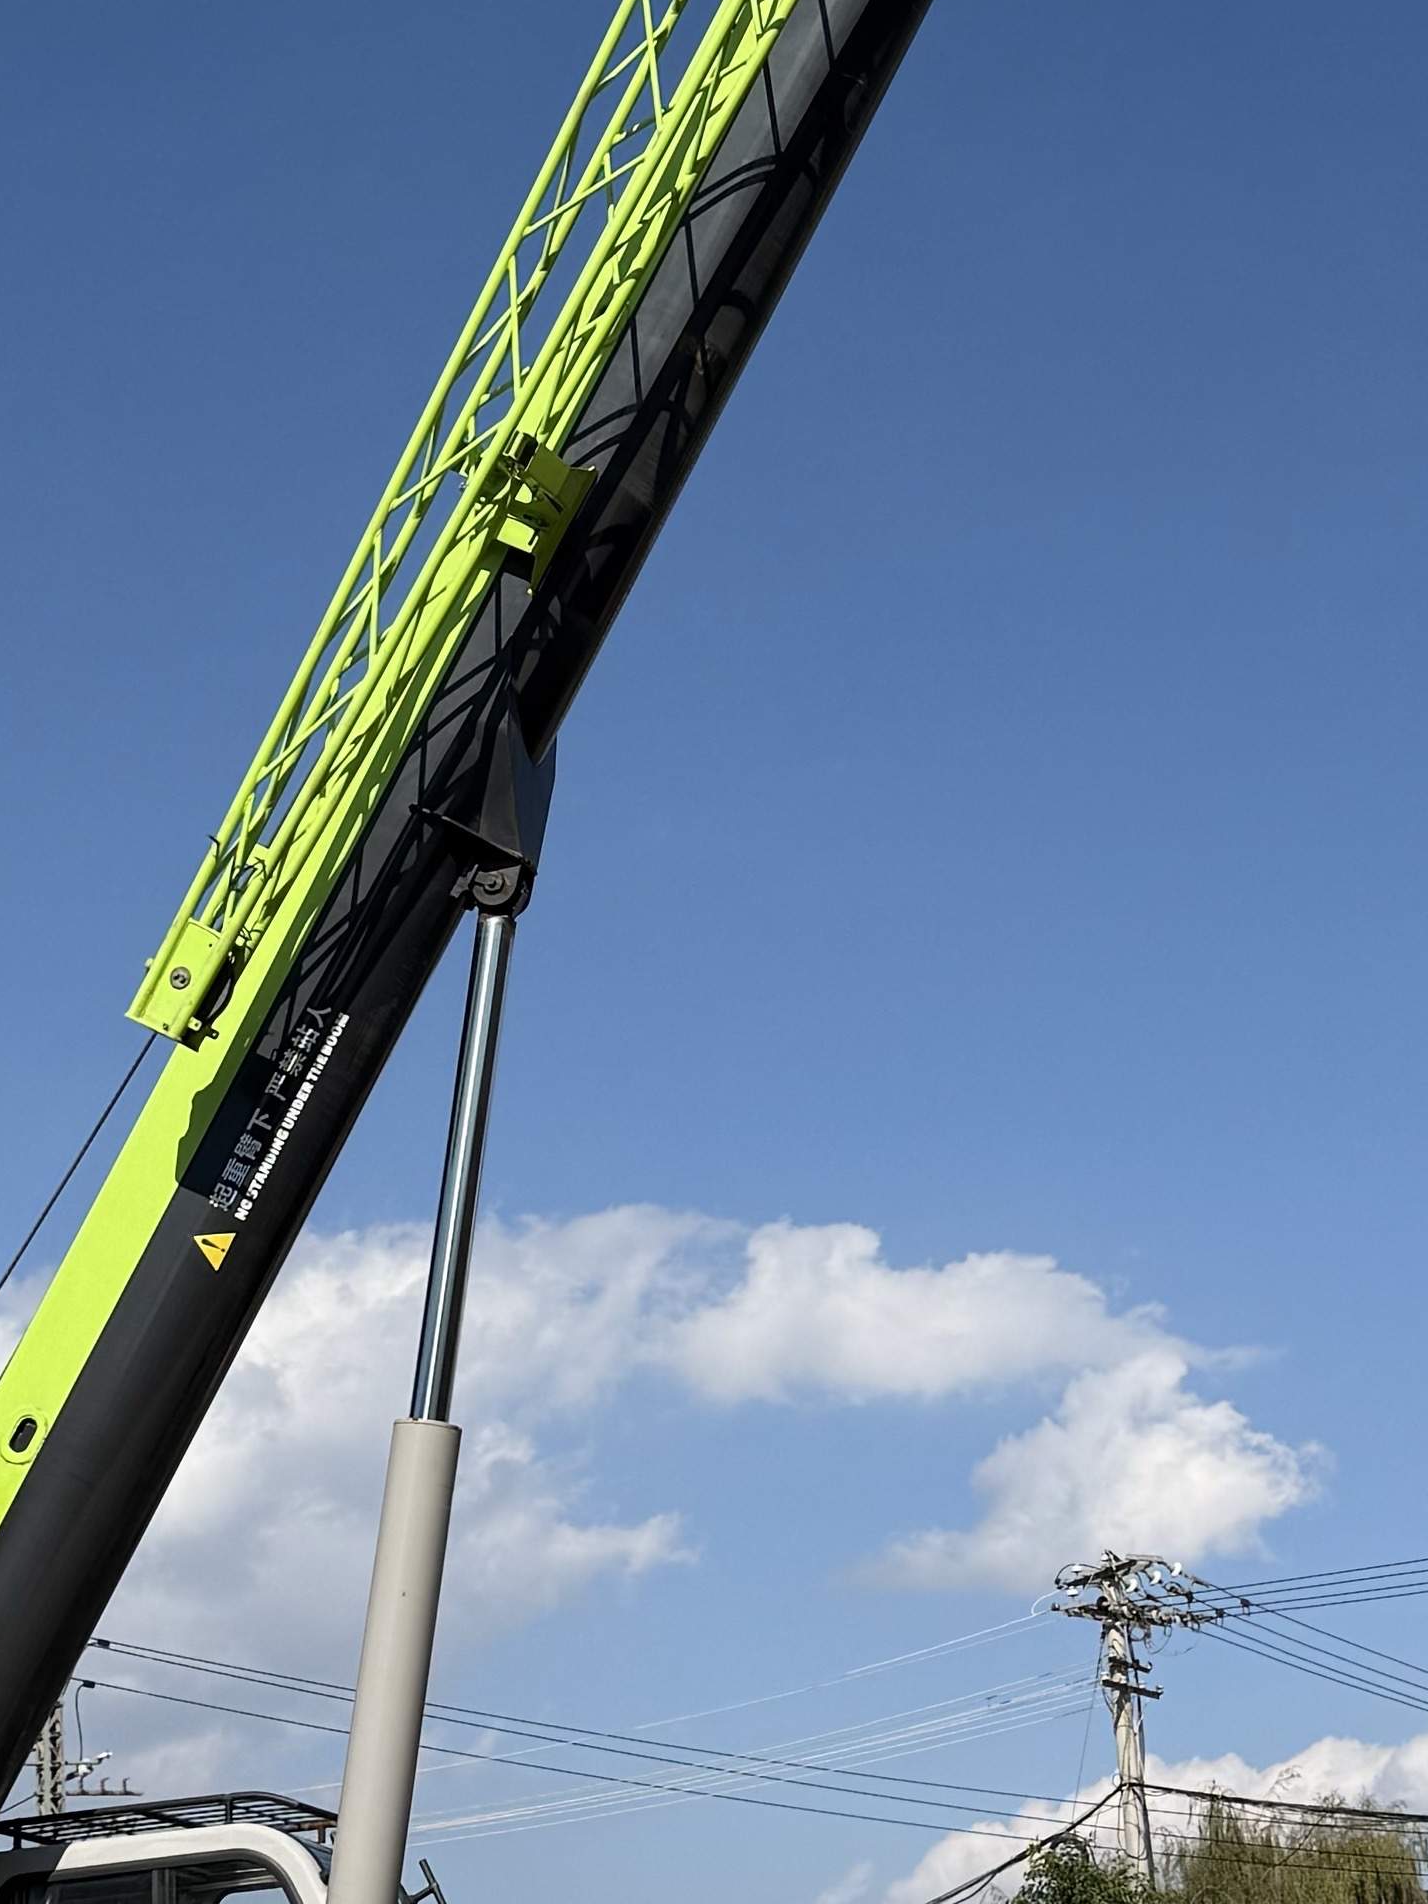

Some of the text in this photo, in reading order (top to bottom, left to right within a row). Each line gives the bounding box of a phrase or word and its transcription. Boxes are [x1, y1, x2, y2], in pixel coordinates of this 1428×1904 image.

[209, 1007, 331, 1212] 起重臂下 严禁站人
[234, 1196, 253, 1221] NO
[246, 1128, 290, 1201] STANDING
[282, 1081, 314, 1131] UNDER
